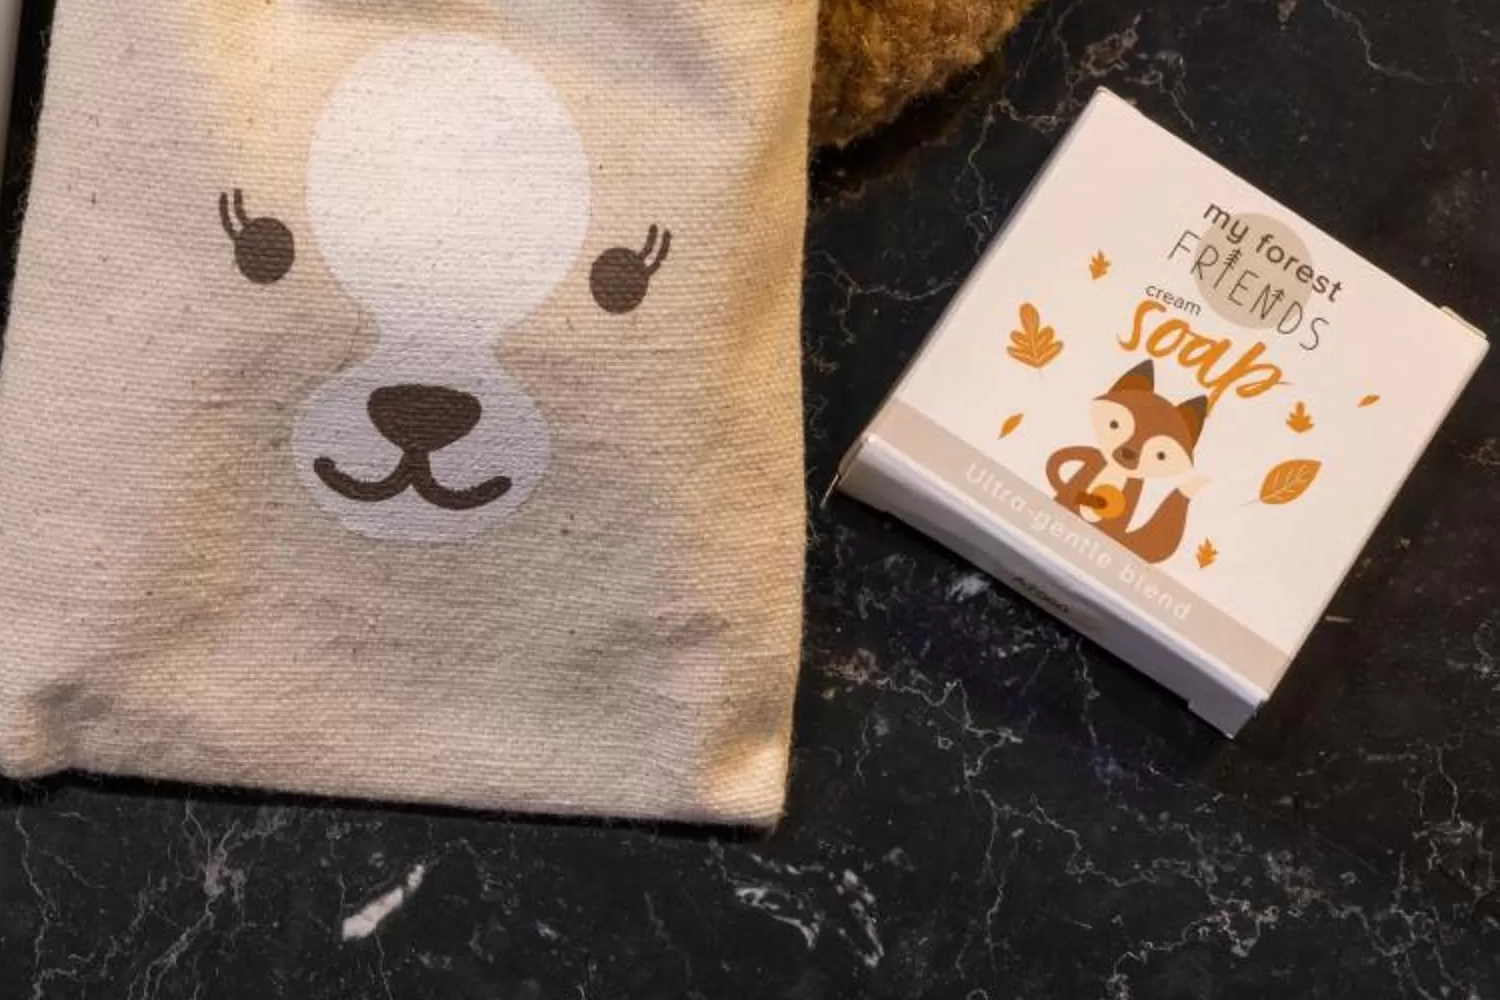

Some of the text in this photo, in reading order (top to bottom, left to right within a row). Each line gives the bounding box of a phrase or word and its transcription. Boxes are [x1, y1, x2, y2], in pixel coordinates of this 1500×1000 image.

[1144, 284, 1202, 316] cream
[1167, 229, 1330, 351] FRIENDS
[1203, 203, 1343, 303] my forest
[1116, 299, 1293, 419] soap
[1118, 564, 1193, 622] blend
